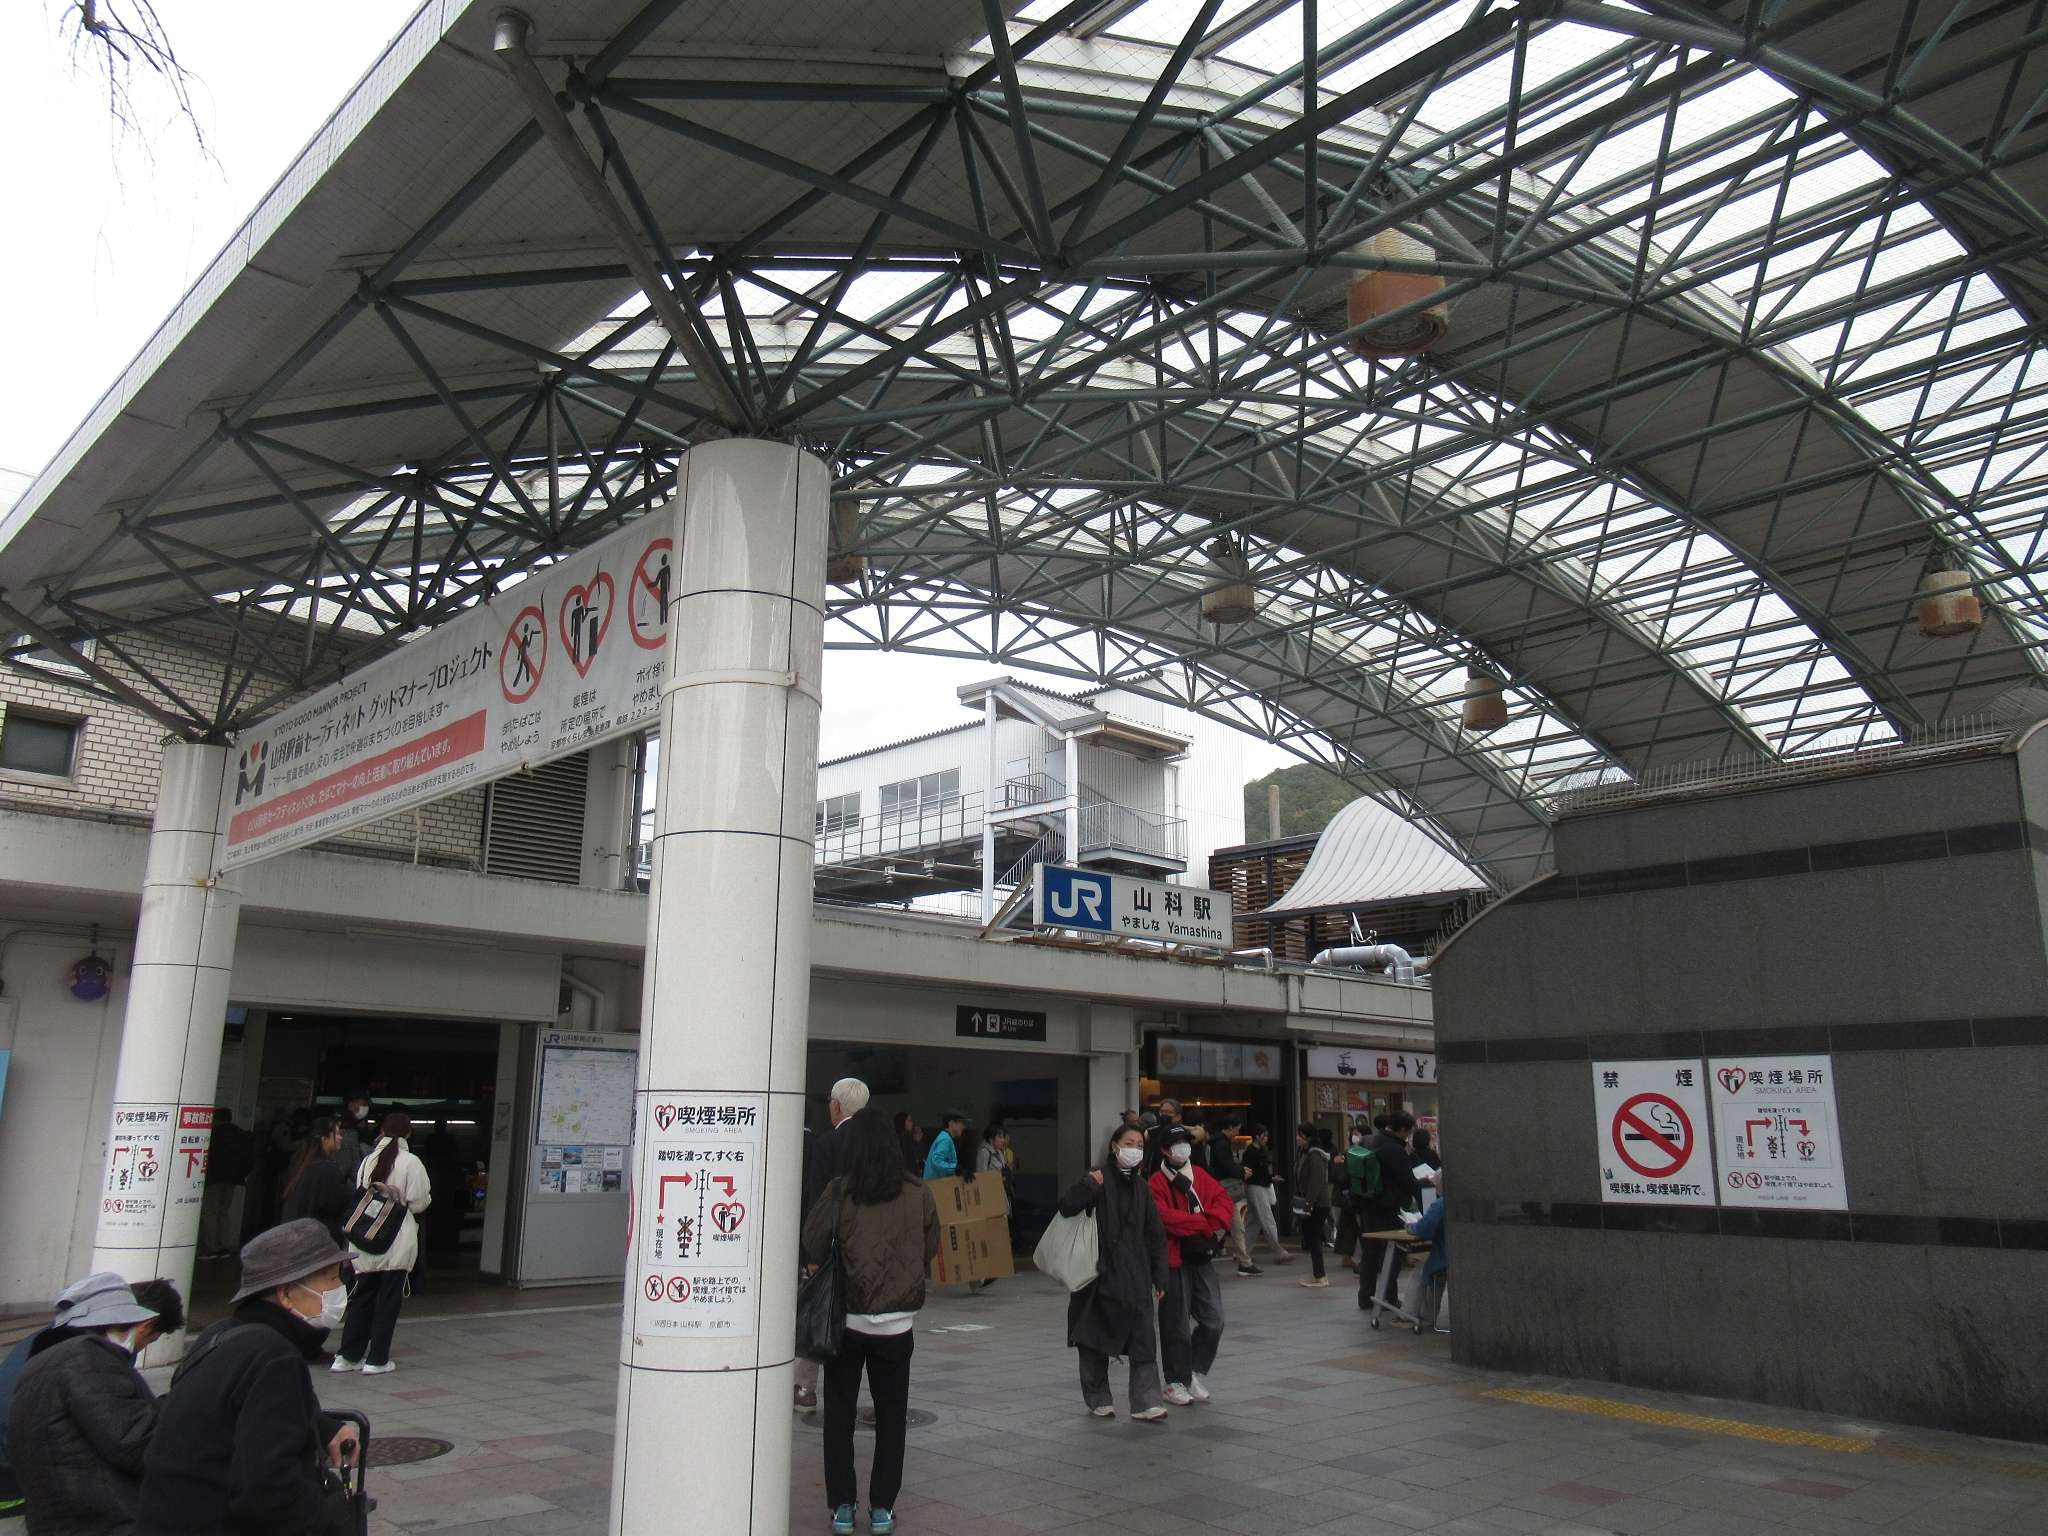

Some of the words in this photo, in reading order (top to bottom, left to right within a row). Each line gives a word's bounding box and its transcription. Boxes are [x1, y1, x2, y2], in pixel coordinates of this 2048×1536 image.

[368, 641, 492, 723] グッドマナープロジェクト
[1051, 878, 1103, 922] JR
[1133, 886, 1212, 921] 山科駅
[1122, 914, 1160, 932] やましな
[1168, 921, 1222, 940] Yamashina
[1602, 1069, 1694, 1089] 禁煙
[1748, 1069, 1824, 1085] 喫煙場所
[1753, 1086, 1792, 1095] SMOKING
[1795, 1086, 1817, 1094] AREA
[125, 1111, 169, 1123] 喫煙場所
[677, 1105, 757, 1126] 喫煙場所
[1609, 1182, 1706, 1196] 喫煙は、喫煙場所で。
[655, 1228, 664, 1259] 現在地
[712, 1233, 742, 1242] 喫煙場所
